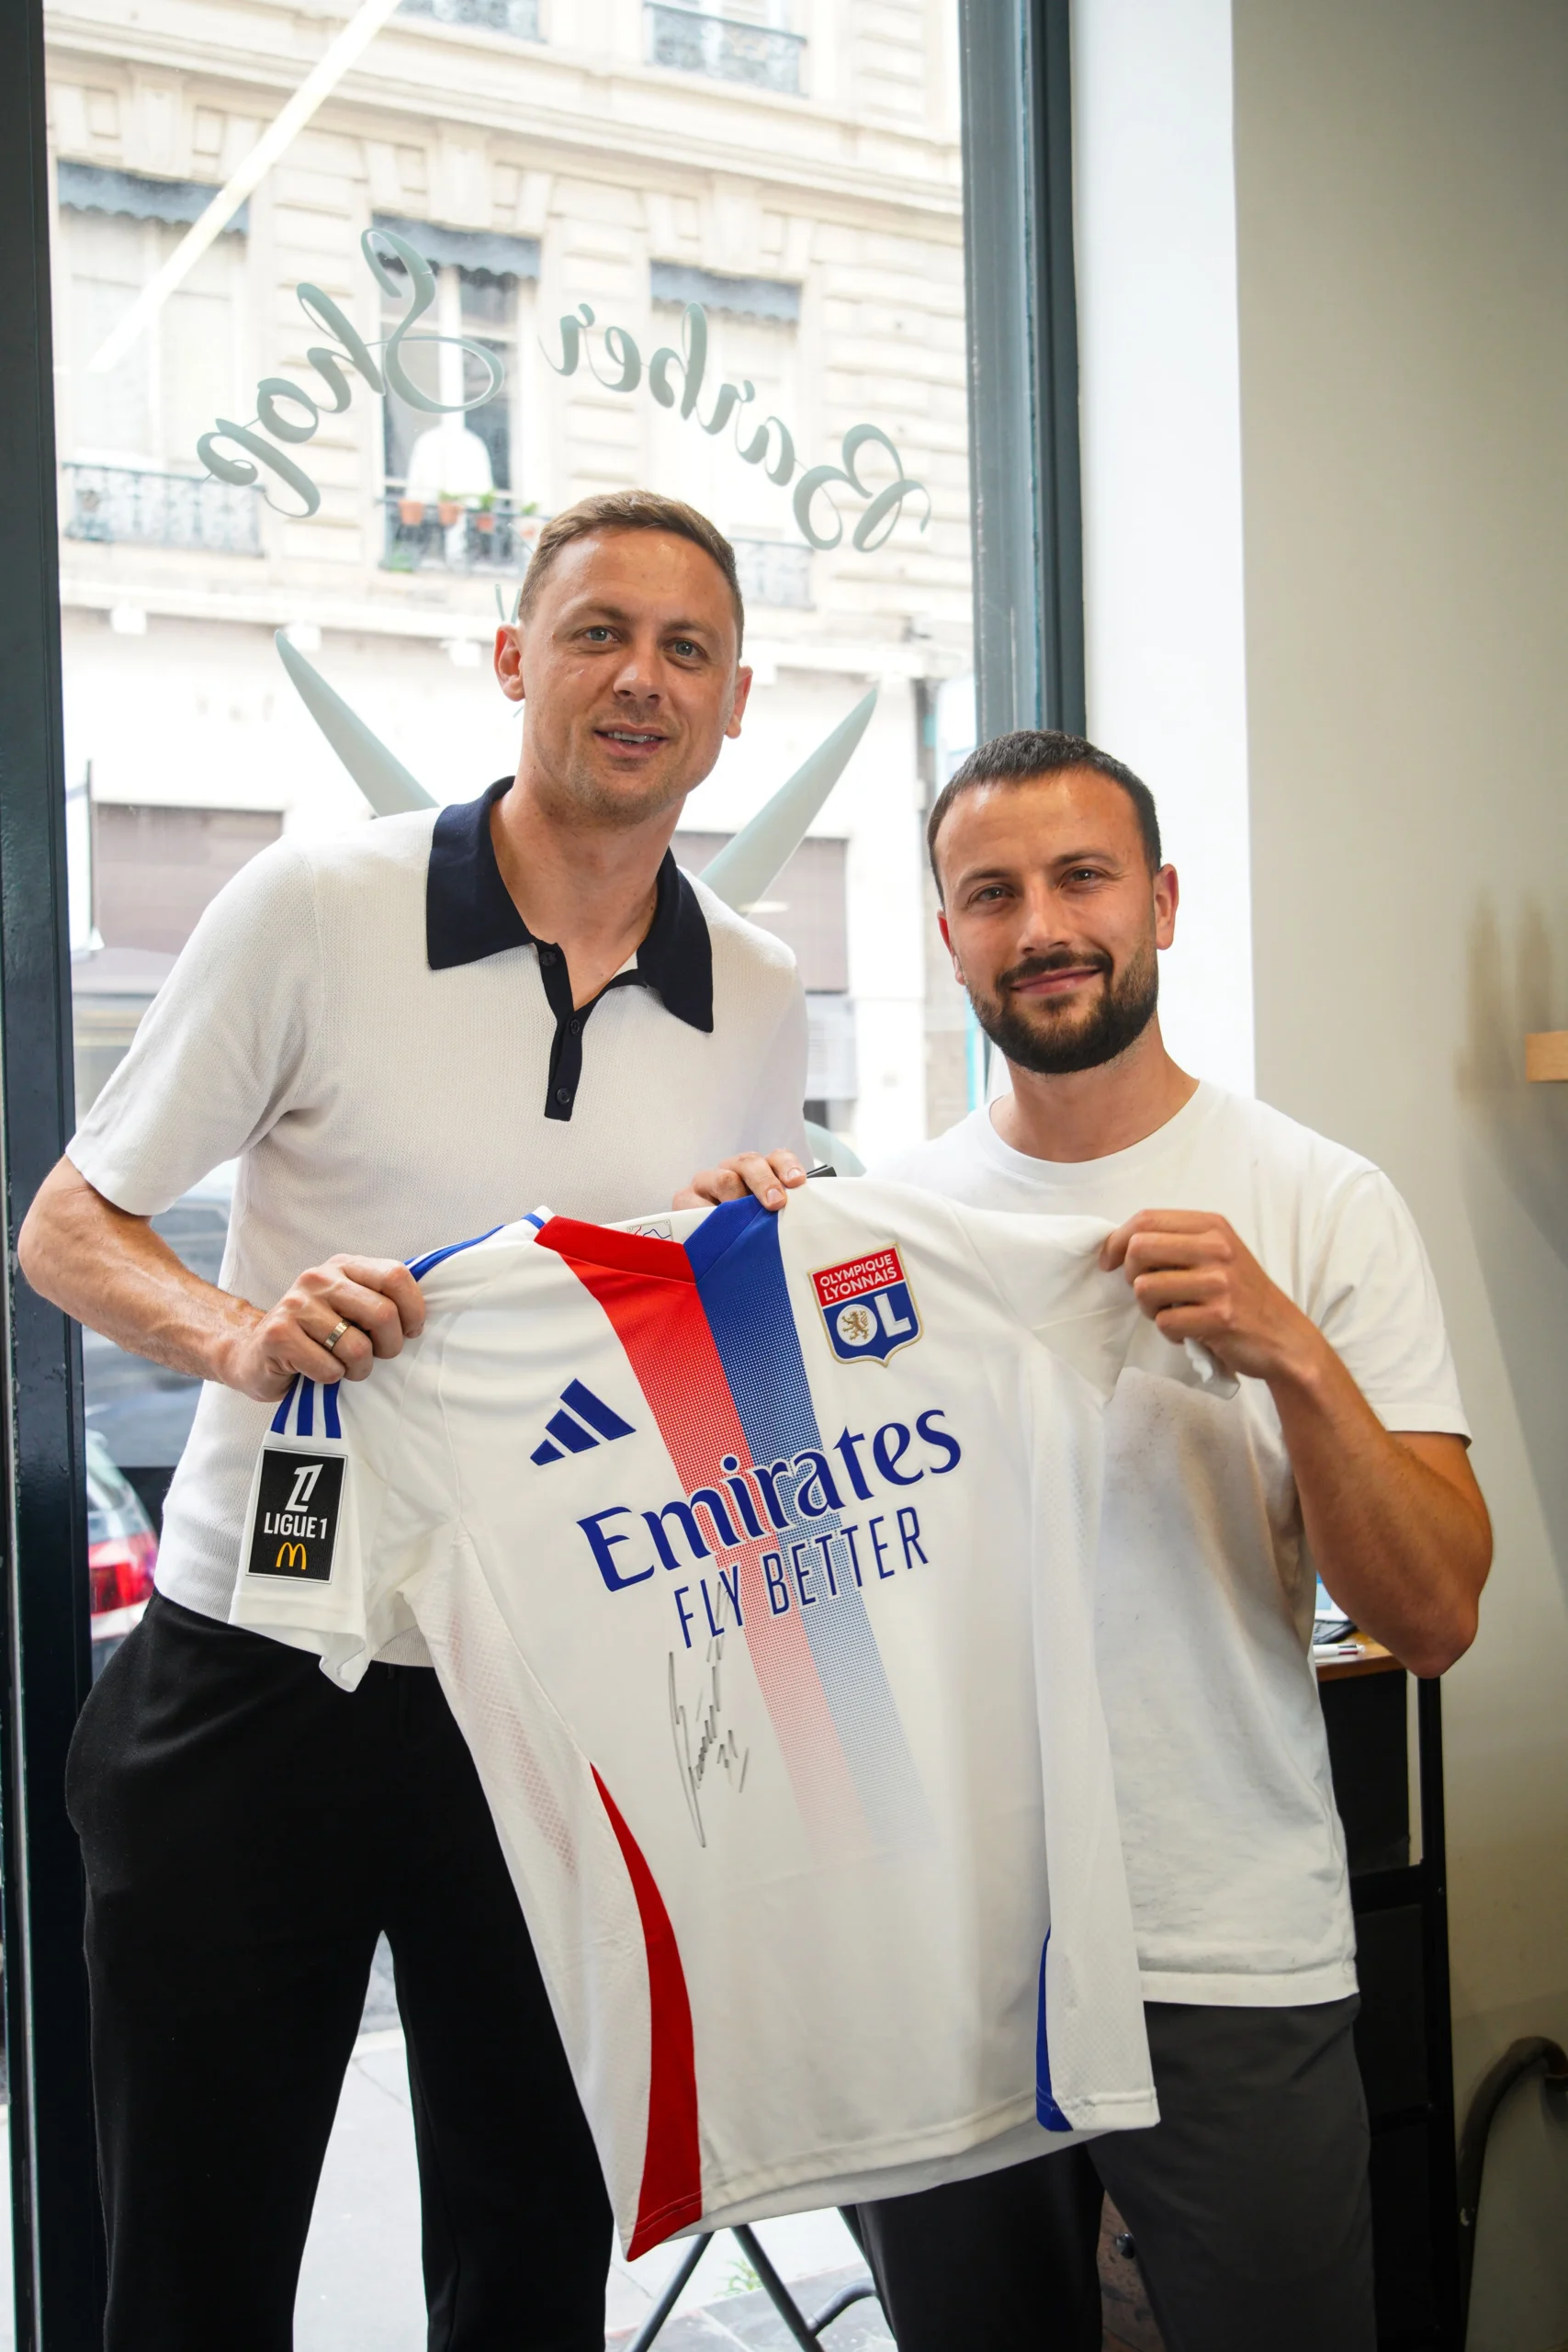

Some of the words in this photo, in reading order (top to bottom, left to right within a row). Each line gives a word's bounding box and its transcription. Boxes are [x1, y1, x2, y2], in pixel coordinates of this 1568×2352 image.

[819, 1254, 893, 1286] OLYMPIQUE
[823, 1267, 897, 1301] LYONNAIS
[577, 1409, 962, 1592] Emirates
[264, 1511, 318, 1538] LIGUE
[673, 1565, 743, 1648] FLY
[762, 1506, 929, 1615] BETTER
